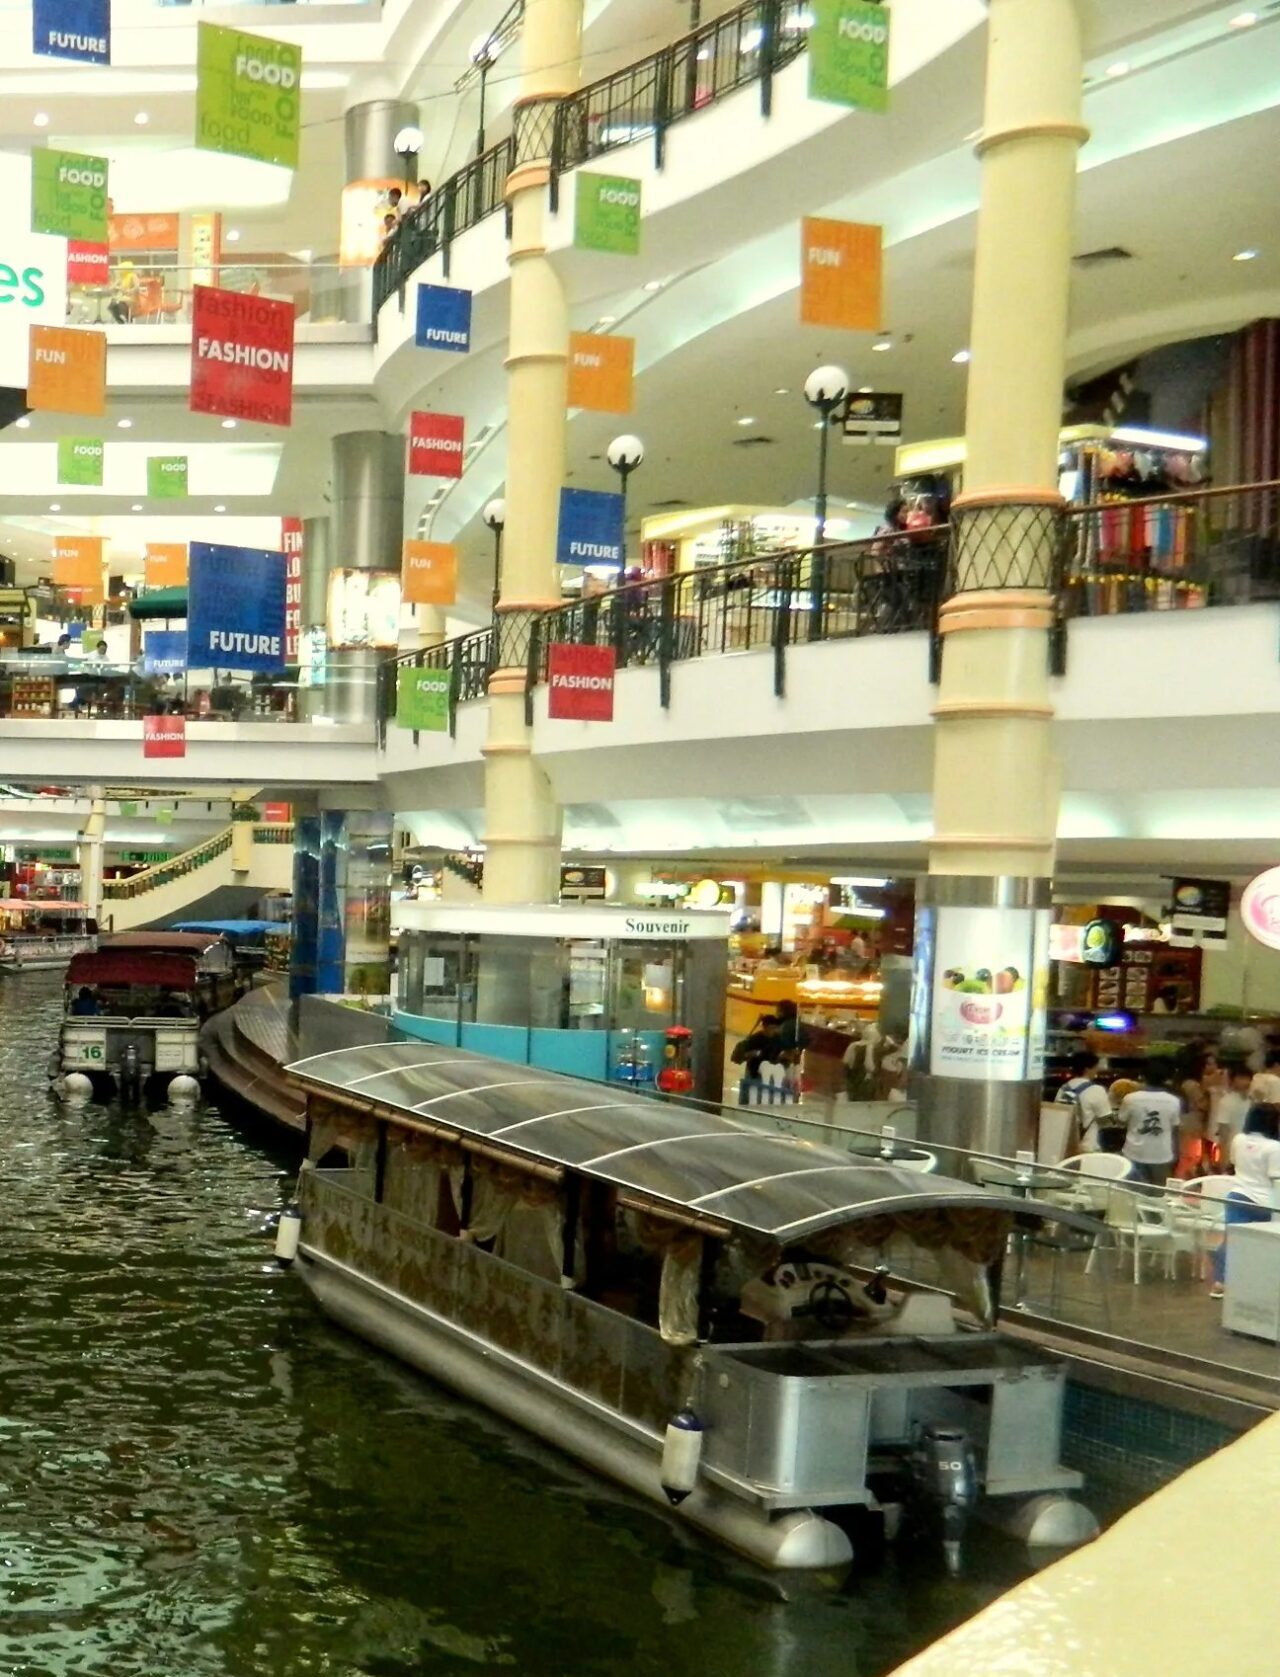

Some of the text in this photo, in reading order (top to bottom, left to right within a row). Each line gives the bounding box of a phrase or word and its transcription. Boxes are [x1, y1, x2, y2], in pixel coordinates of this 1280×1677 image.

[839, 17, 886, 44] FOOD
[48, 30, 107, 54] FUTURE
[236, 55, 295, 88] FOOD
[59, 167, 104, 187] FOOD
[599, 188, 638, 206] FOOD
[67, 253, 107, 264] ASHION
[807, 247, 840, 266] FUN
[426, 328, 468, 345] FUTURE
[34, 348, 66, 365] FUN
[198, 337, 290, 373] FASHION
[573, 353, 601, 368] FUN
[73, 445, 103, 457] FOOD
[411, 436, 462, 453] FASHION
[161, 462, 187, 473] FOOD
[570, 541, 619, 560] FUTURE
[409, 557, 432, 570] FUN
[209, 631, 281, 657] FUTURE
[152, 658, 185, 668] FUTURE
[416, 680, 448, 693] FOOD
[552, 674, 613, 691] FASHION
[145, 731, 184, 742] FASHION
[625, 918, 690, 934] Souvenir
[82, 1045, 102, 1060] 16
[938, 1460, 962, 1471] 50
